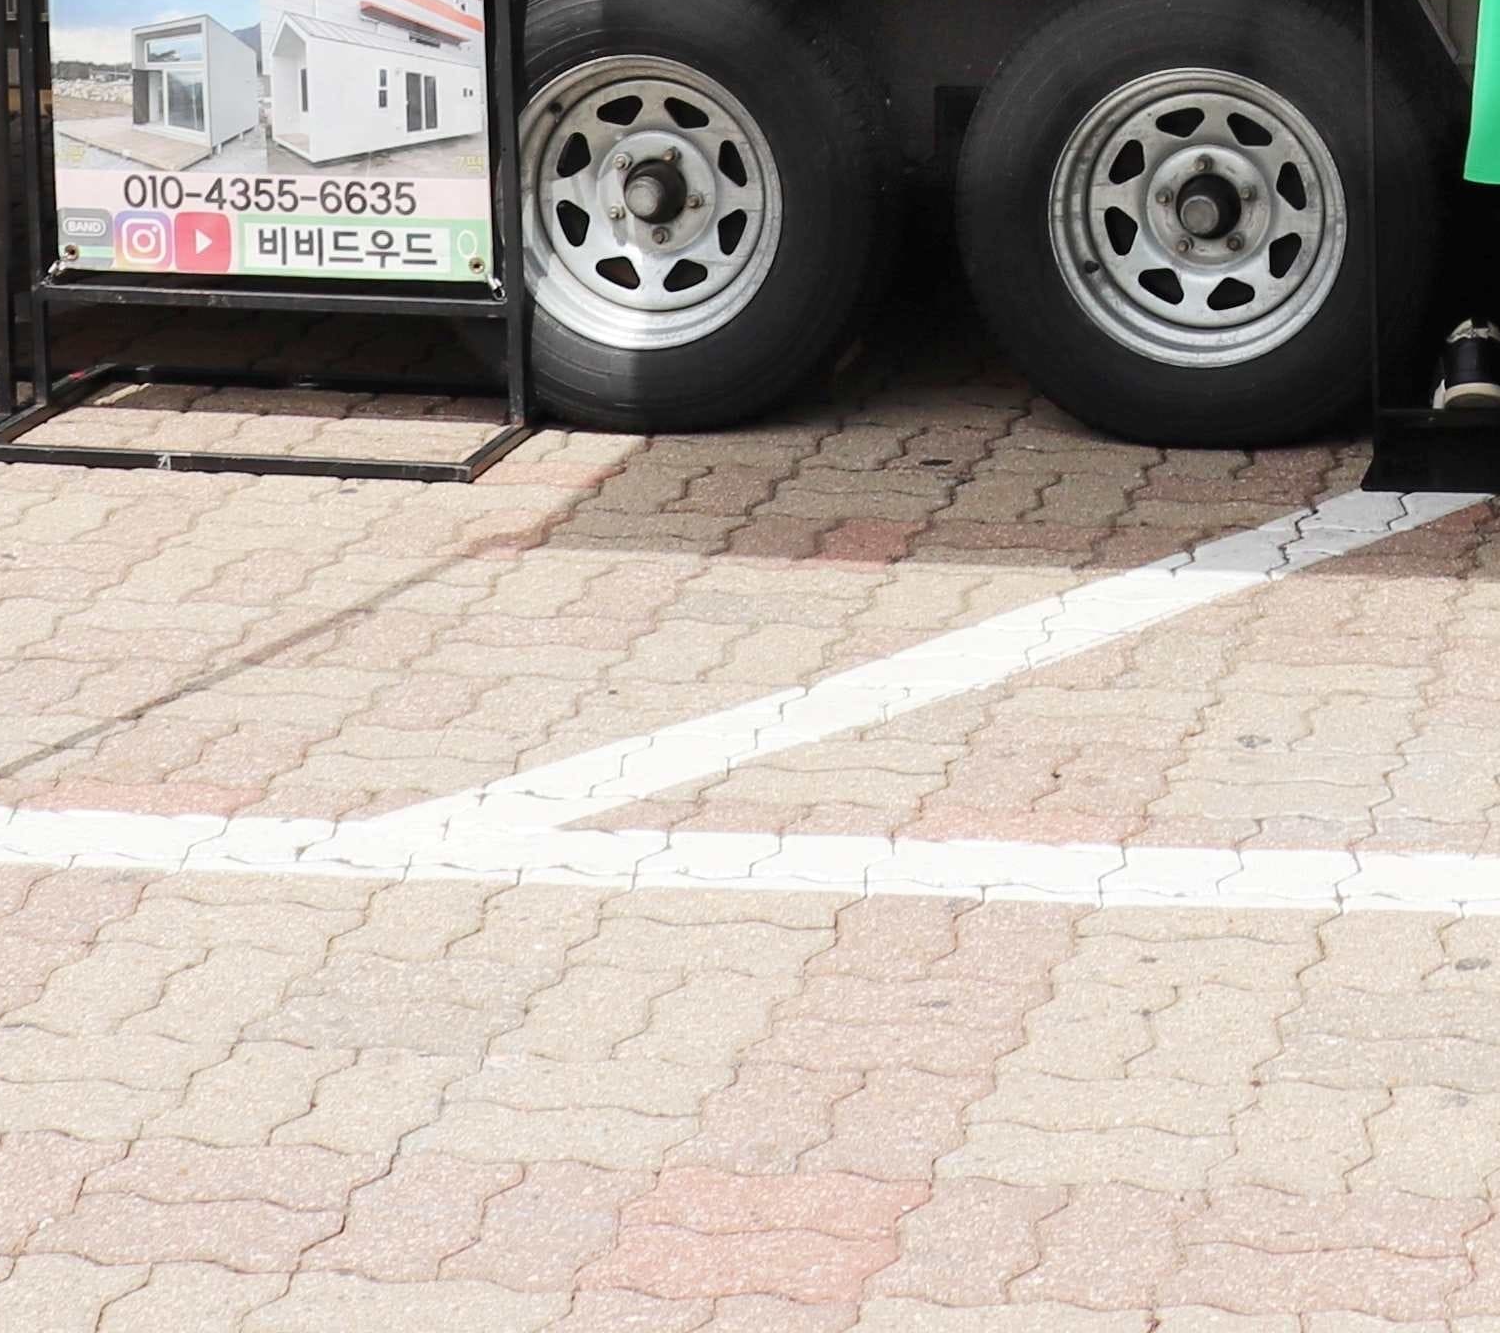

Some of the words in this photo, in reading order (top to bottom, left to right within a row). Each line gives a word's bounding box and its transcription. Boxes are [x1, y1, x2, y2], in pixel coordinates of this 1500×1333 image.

[123, 174, 417, 215] 010-4355-6635
[67, 220, 103, 234] BAND
[258, 226, 438, 266] 비비드우드
